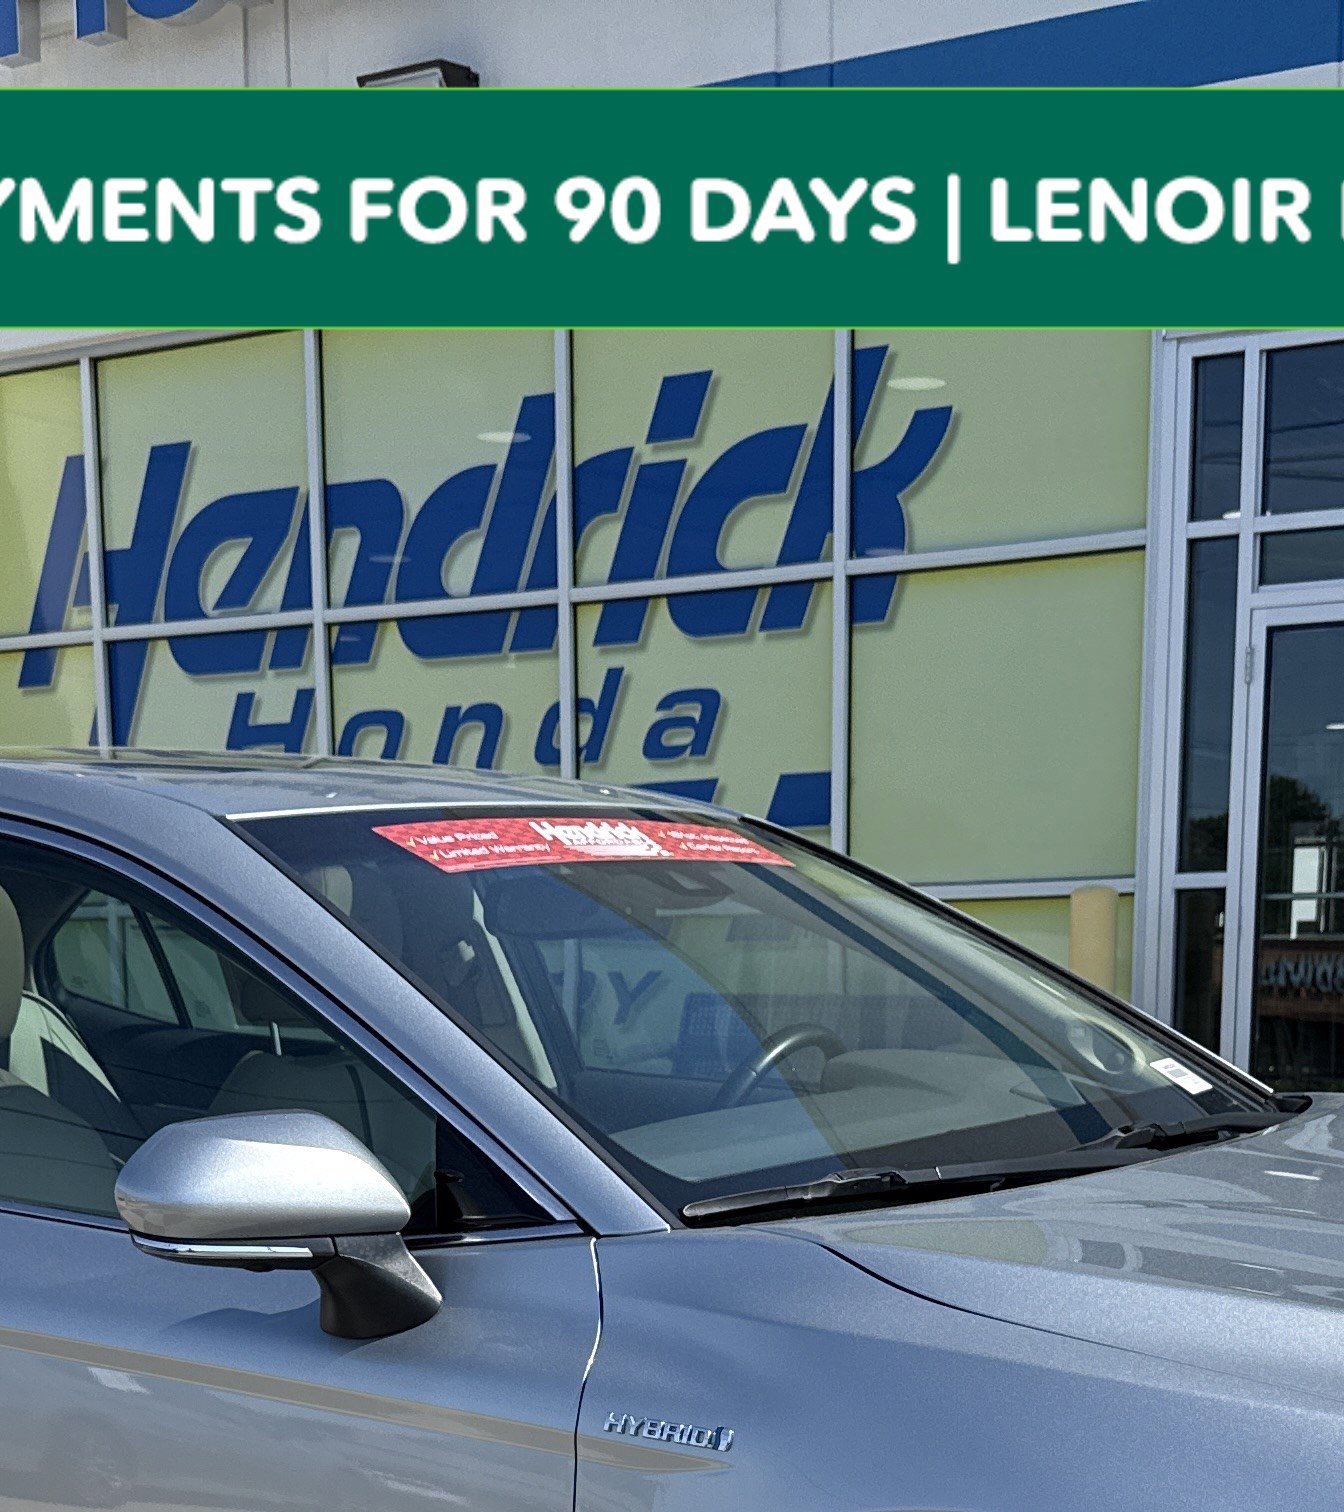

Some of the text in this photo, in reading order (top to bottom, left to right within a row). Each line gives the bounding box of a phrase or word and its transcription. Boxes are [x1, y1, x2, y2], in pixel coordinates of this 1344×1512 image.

[17, 343, 953, 755] Hendrick
[223, 665, 723, 769] Honda
[416, 832, 455, 845] Value
[603, 1411, 713, 1449] HYBRID
